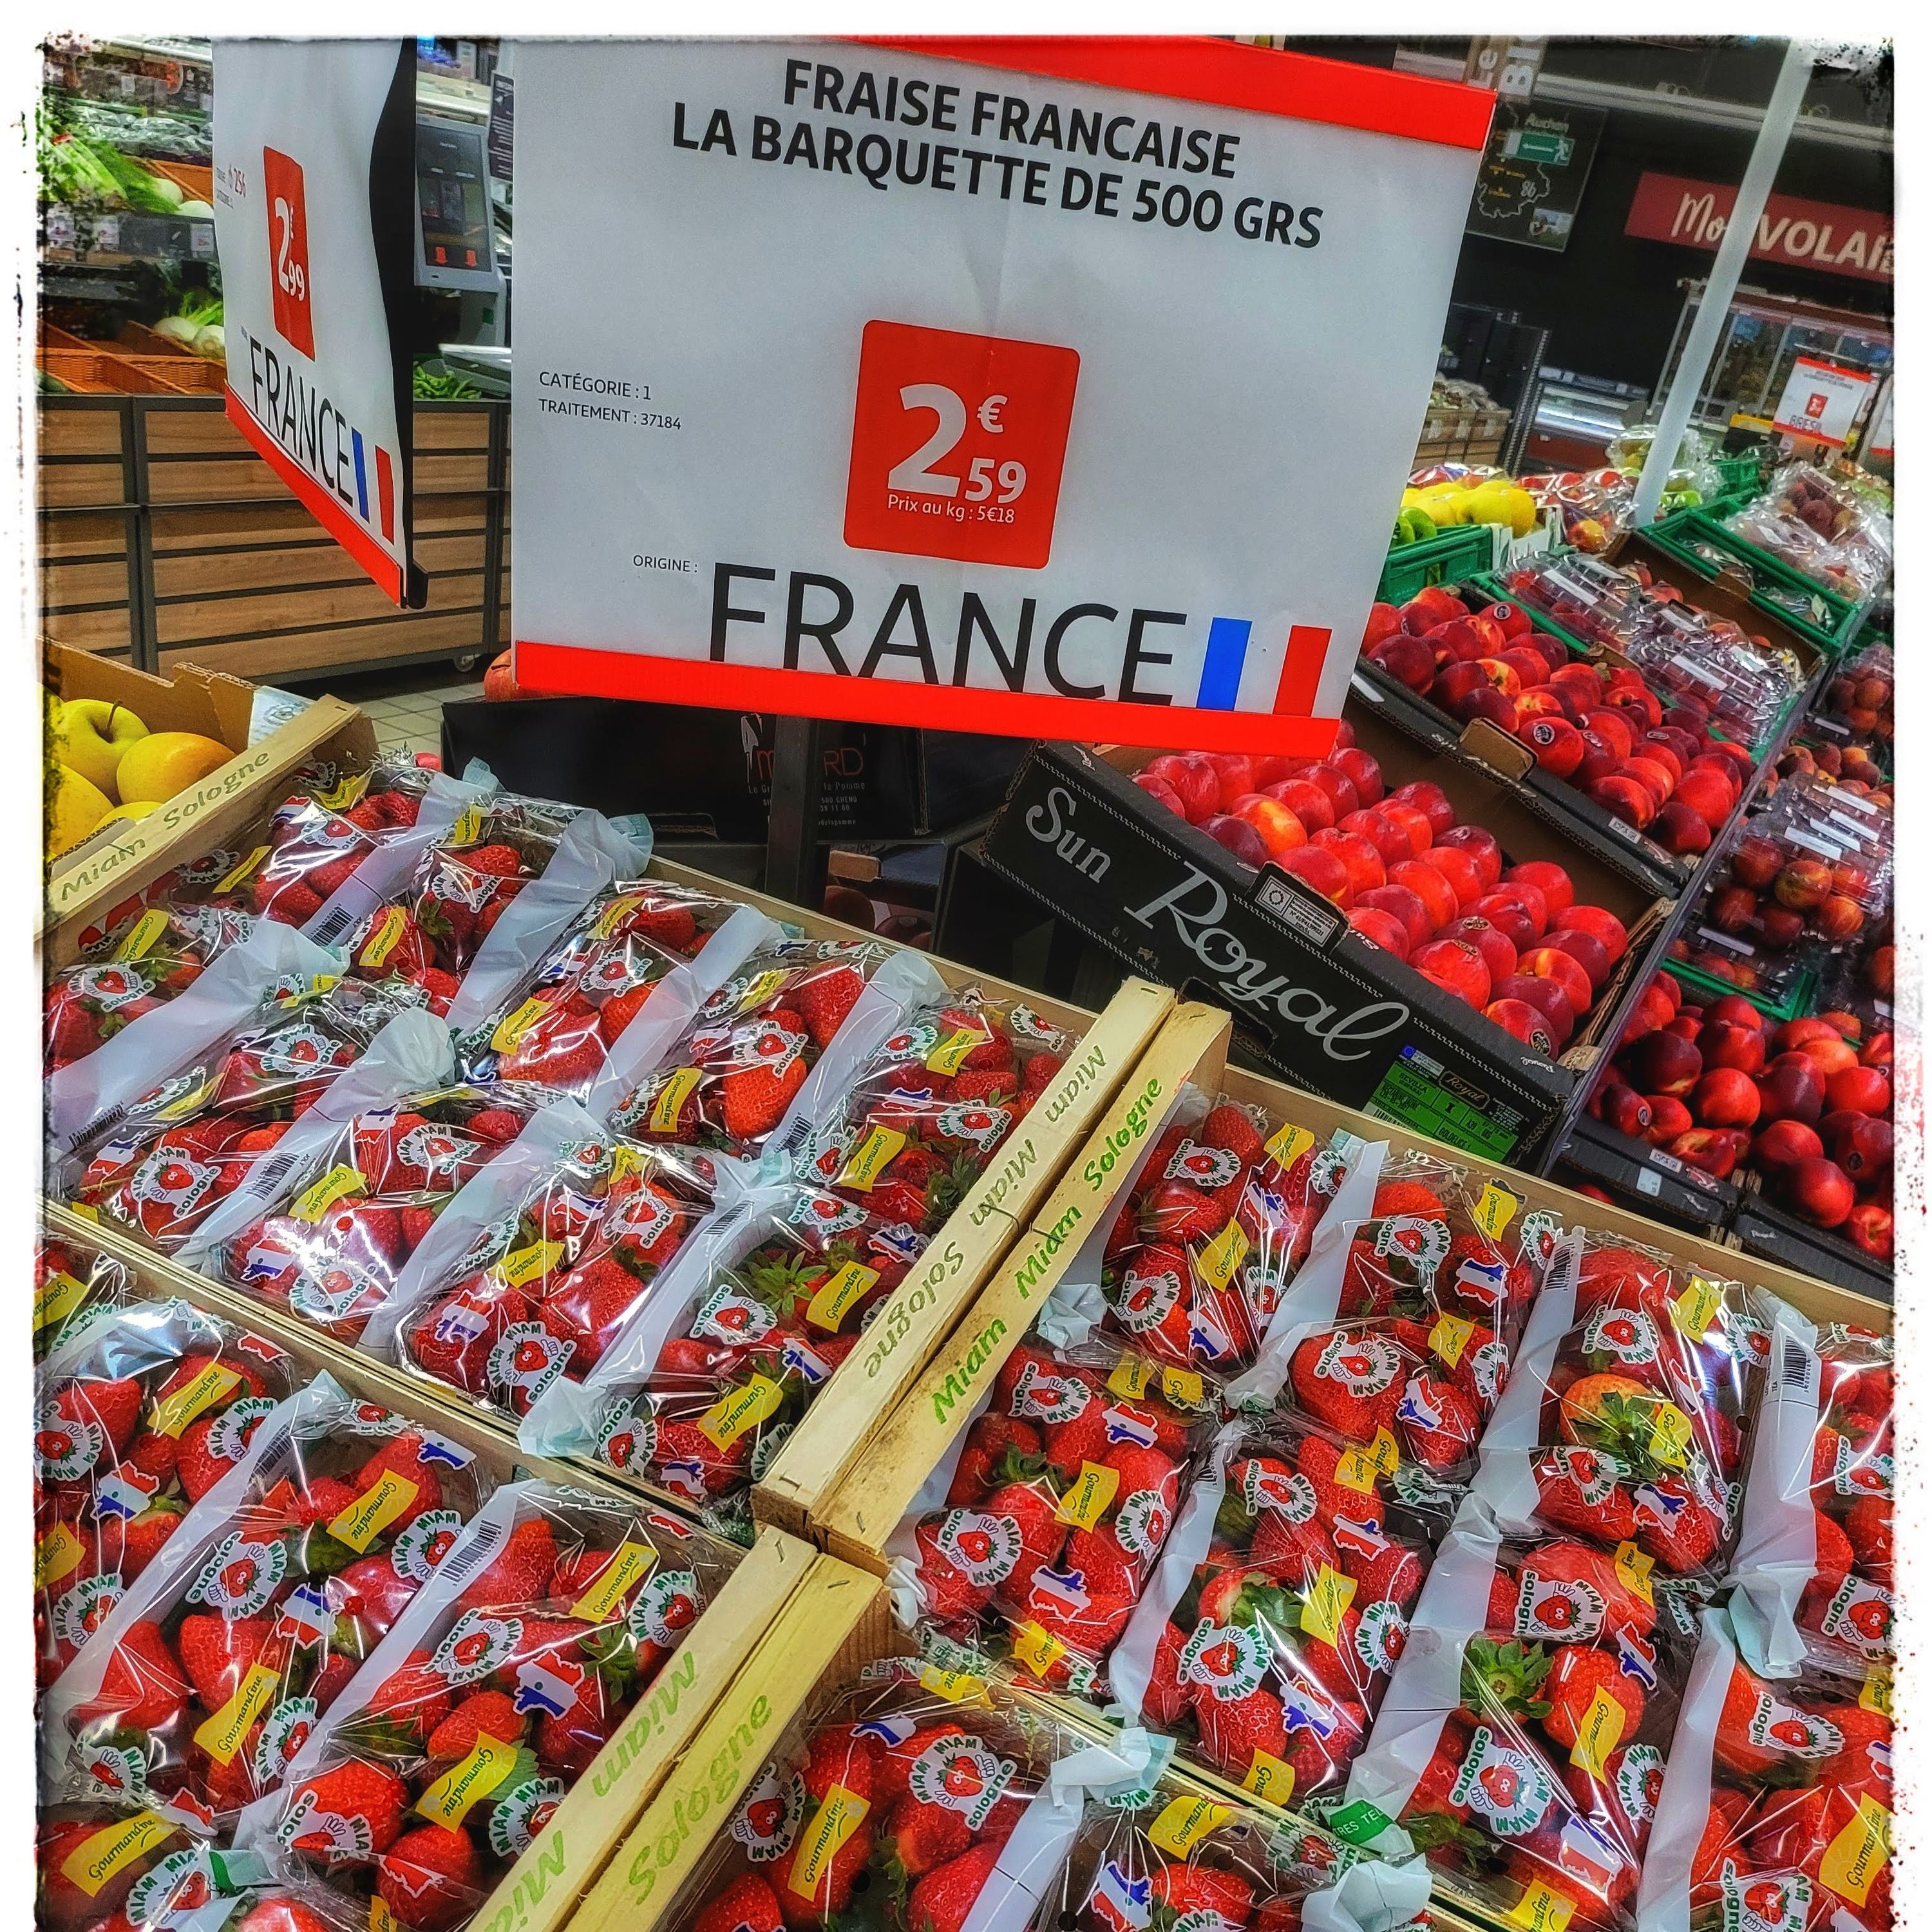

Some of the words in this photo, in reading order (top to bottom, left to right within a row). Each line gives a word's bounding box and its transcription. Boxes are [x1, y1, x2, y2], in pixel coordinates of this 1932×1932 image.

[783, 59, 960, 132] FRAISE
[972, 91, 1240, 178] FRANCAISE
[672, 102, 737, 157] LA
[751, 115, 1051, 206] BARQUETTE
[1061, 167, 1123, 218] DE
[1132, 180, 1224, 232] 500
[1234, 196, 1323, 249] GRS
[275, 197, 289, 293] 2
[1671, 193, 1728, 243] Mo
[289, 260, 305, 301] 99
[540, 371, 631, 397] CATÉGORIE
[643, 386, 651, 400] 1
[250, 335, 352, 507] FRANCE
[538, 399, 630, 422] TRAITEMENT
[641, 413, 681, 430] 37184
[887, 383, 967, 498] 2
[965, 457, 1027, 504] 59
[888, 494, 918, 512] Prix
[922, 502, 942, 515] au
[947, 501, 965, 522] kg
[977, 506, 1015, 523] 5€18
[633, 554, 690, 573] ORIGINE
[709, 562, 1188, 706] FRANCE
[835, 782, 865, 790] Pomme
[62, 837, 146, 902] Miam
[162, 752, 270, 830] Sologne
[1026, 788, 1112, 884] Sun
[1124, 860, 1410, 1061] Royal
[102, 980, 153, 1010] sologne
[774, 1032, 806, 1077] sologne
[1045, 1045, 1108, 1123] Miam
[1399, 1073, 1428, 1094] SEVILLA
[1446, 1077, 1484, 1102] Royal
[442, 1142, 478, 1175] sologne
[796, 1132, 818, 1179] sologne
[981, 1111, 1010, 1151] sologne
[1166, 1139, 1192, 1178] sologne
[176, 1167, 218, 1217] sologne
[969, 1139, 1037, 1227] Miam
[930, 1318, 1009, 1425] Miam
[1014, 1206, 1083, 1300] Miam
[1083, 1077, 1163, 1192] Sologne
[693, 1286, 730, 1336] sologne
[863, 1242, 965, 1378] Sologne
[527, 1341, 574, 1403] sologne
[1317, 1334, 1345, 1377] sologne
[1012, 1363, 1035, 1415] sologne
[1247, 1460, 1260, 1515] sologne
[1835, 1438, 1850, 1495] sologne
[189, 1532, 242, 1600] sologne
[1517, 1571, 1537, 1637] sologn
[1179, 1618, 1212, 1681] sologne
[592, 1651, 697, 1798] Miam
[1752, 1692, 1774, 1746] sologne
[1452, 1728, 1489, 1803] sologne
[629, 1694, 773, 1906] Sologne
[967, 1762, 1014, 1827] sologne
